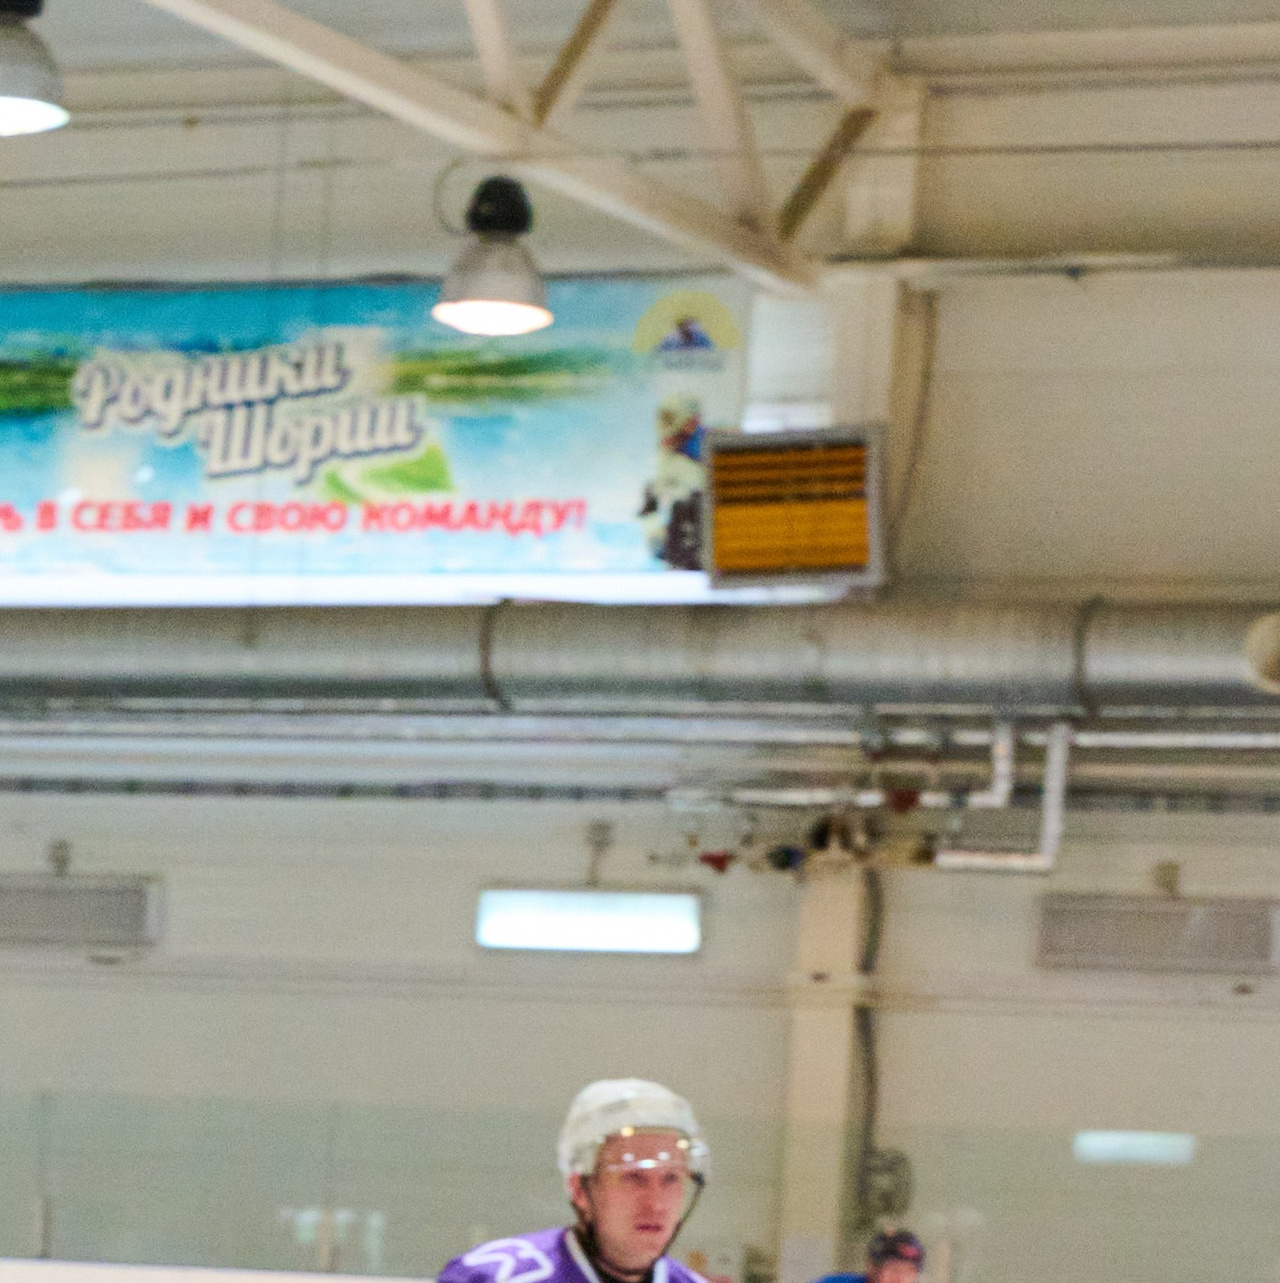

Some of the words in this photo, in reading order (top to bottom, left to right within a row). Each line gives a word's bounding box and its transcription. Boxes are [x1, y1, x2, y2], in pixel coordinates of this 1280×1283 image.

[80, 339, 352, 438] Родники
[35, 500, 58, 532] В
[70, 500, 173, 533] СЕБЯ
[184, 502, 214, 532] И
[226, 501, 349, 533] СВОЮ
[362, 499, 587, 539] КОМАНДУ!
